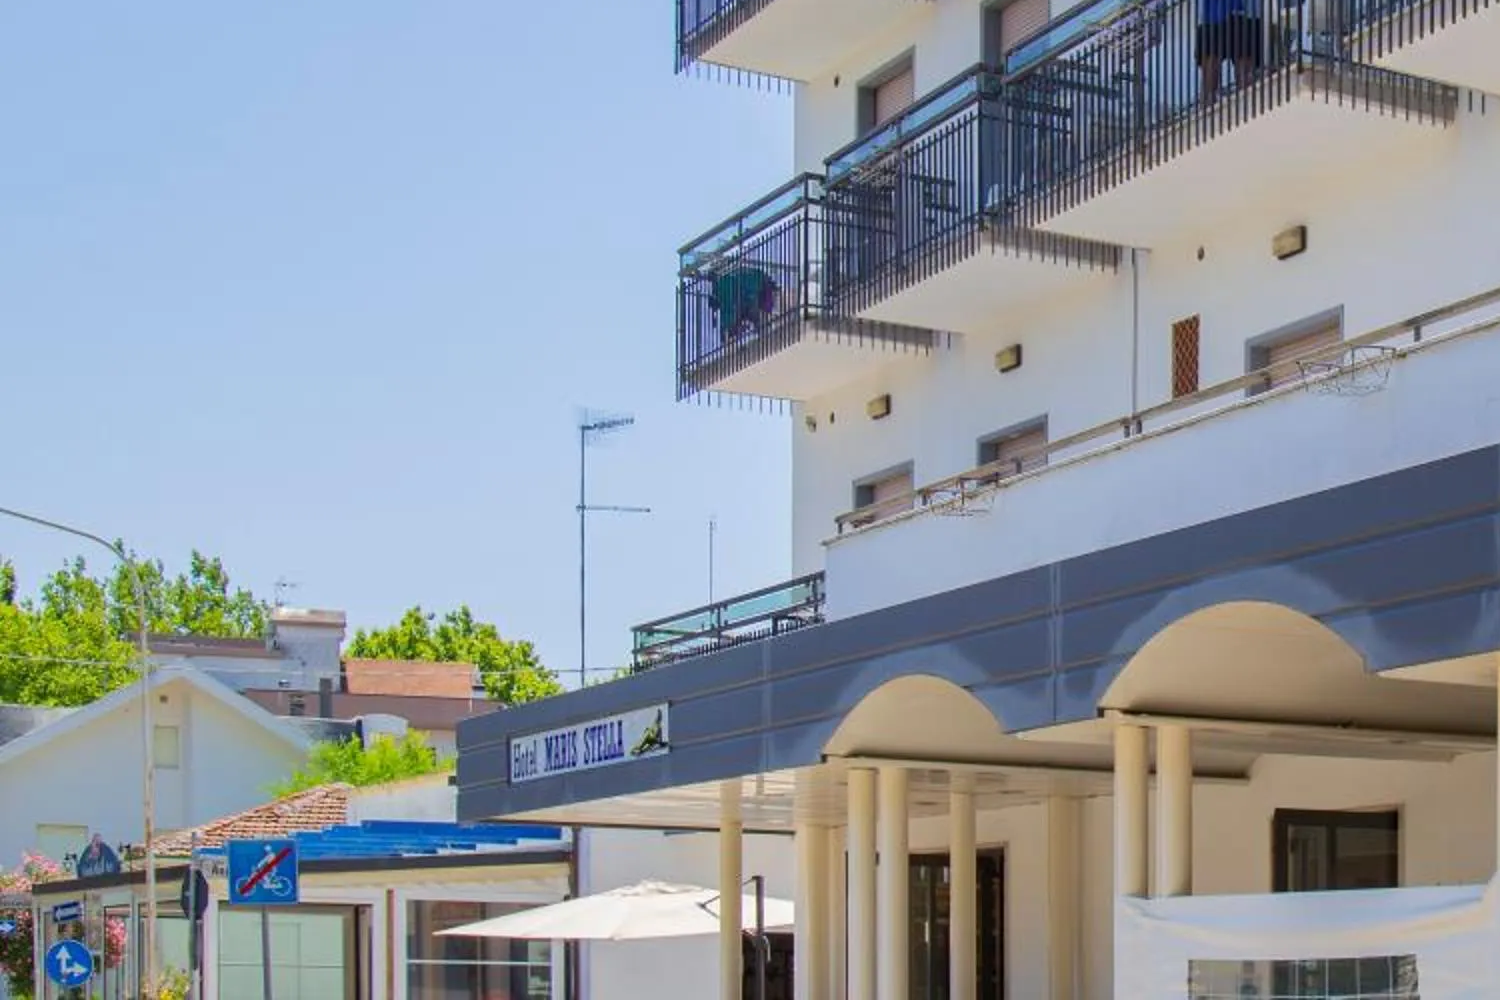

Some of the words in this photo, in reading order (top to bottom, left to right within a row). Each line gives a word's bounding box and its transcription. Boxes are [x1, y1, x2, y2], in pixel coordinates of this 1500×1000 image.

[513, 740, 538, 778] Hotel
[544, 731, 578, 771] MARIS
[583, 720, 625, 765] STELLA
